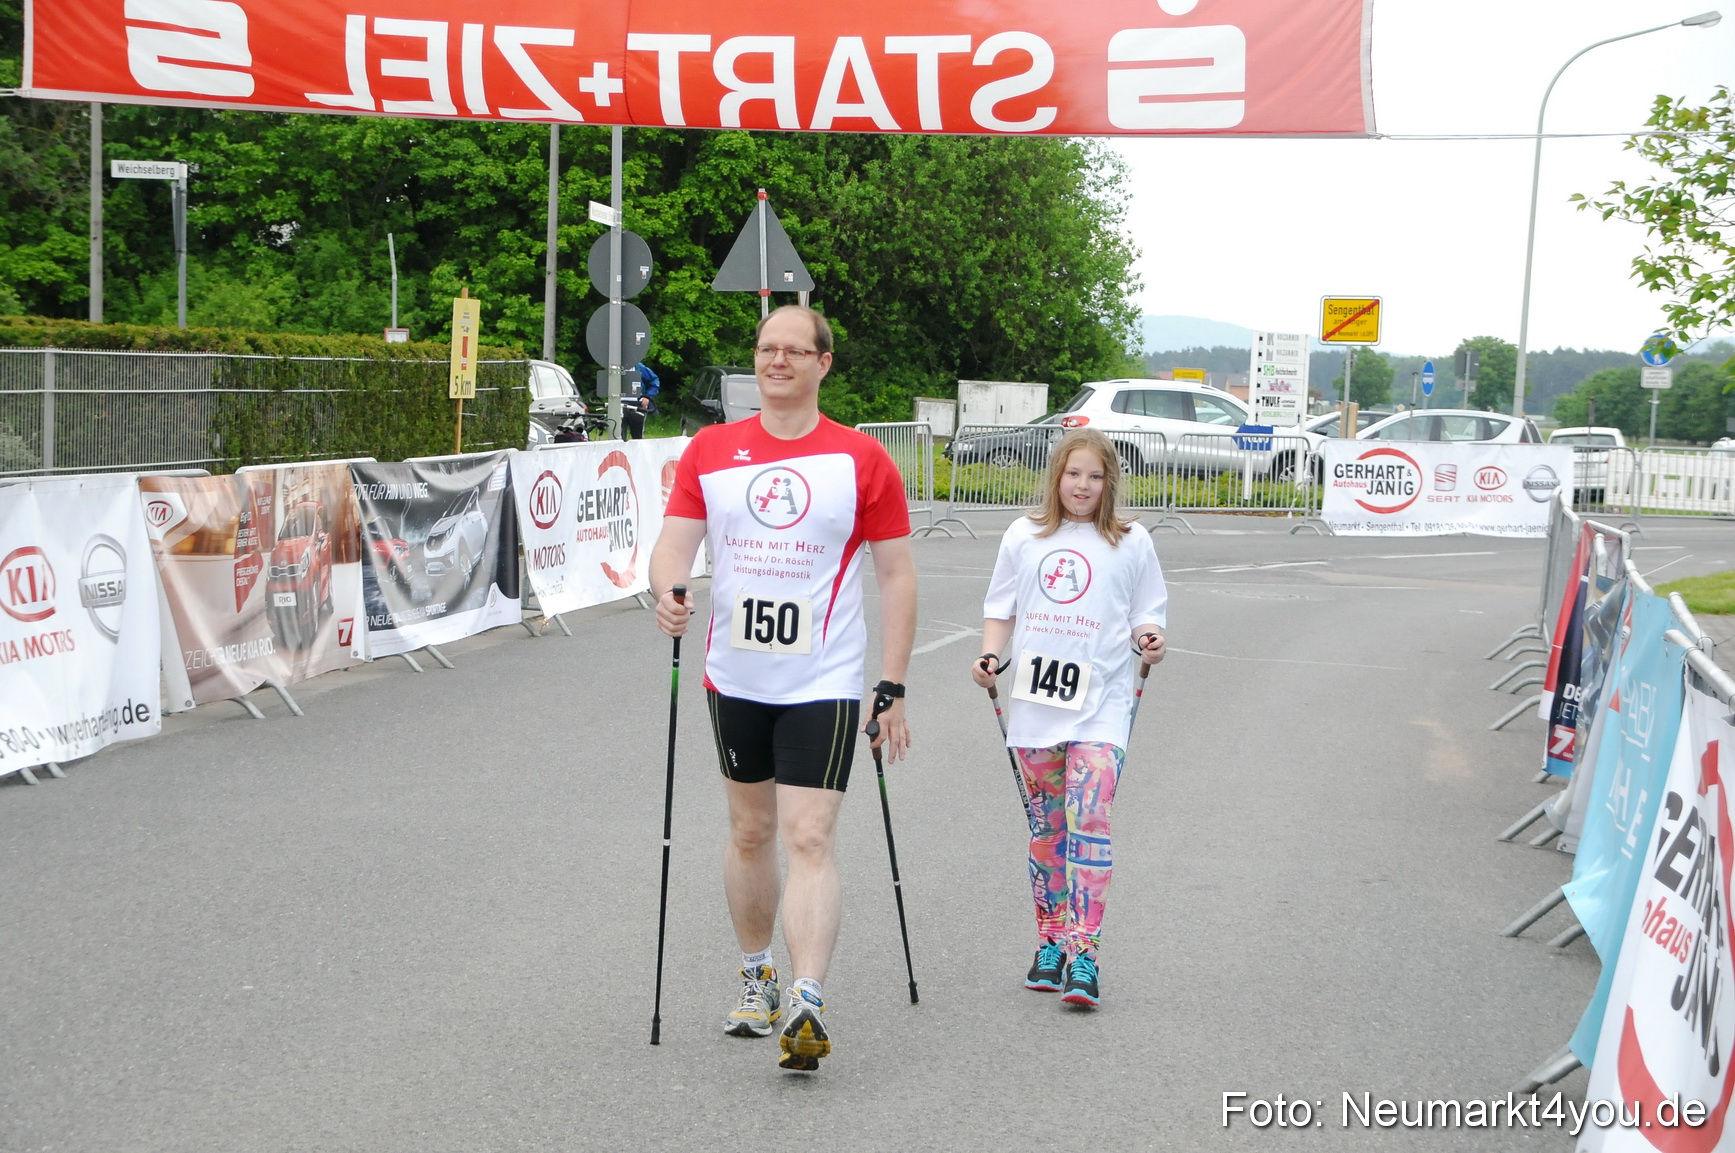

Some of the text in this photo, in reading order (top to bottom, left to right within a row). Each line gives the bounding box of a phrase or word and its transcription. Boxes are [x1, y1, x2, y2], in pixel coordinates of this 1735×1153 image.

[118, 164, 175, 177] Weichselberg
[1328, 304, 1374, 318] Sengenthal
[454, 373, 472, 396] 5 km
[1262, 396, 1280, 407] THULE
[1334, 463, 1405, 479] GERHART
[1479, 472, 1500, 485] KIA
[1333, 479, 1414, 495] Autohaus JÄNIG
[536, 485, 557, 515] KIA
[1480, 495, 1513, 503] MOTORS
[1365, 521, 1404, 533] Sengenthal
[725, 535, 826, 554] LAUFEN MIT HERZ
[533, 542, 566, 571] MOTORS
[734, 553, 743, 561] Dr.
[743, 553, 763, 563] Heck
[771, 555, 783, 564] Dr.
[785, 557, 814, 567] Röschl
[733, 563, 811, 579] Leistungsdiagnostik
[84, 580, 124, 600] NISSA
[278, 595, 292, 604] RIO
[370, 613, 393, 626] NEUE
[742, 597, 800, 646] 150
[1053, 614, 1072, 624] MIT
[1075, 615, 1101, 630] HERZ
[1032, 625, 1049, 633] Heck
[1054, 627, 1065, 635] Dr.
[259, 636, 276, 656] RIO.
[1030, 655, 1081, 702] 149
[1549, 729, 1575, 755] 7
